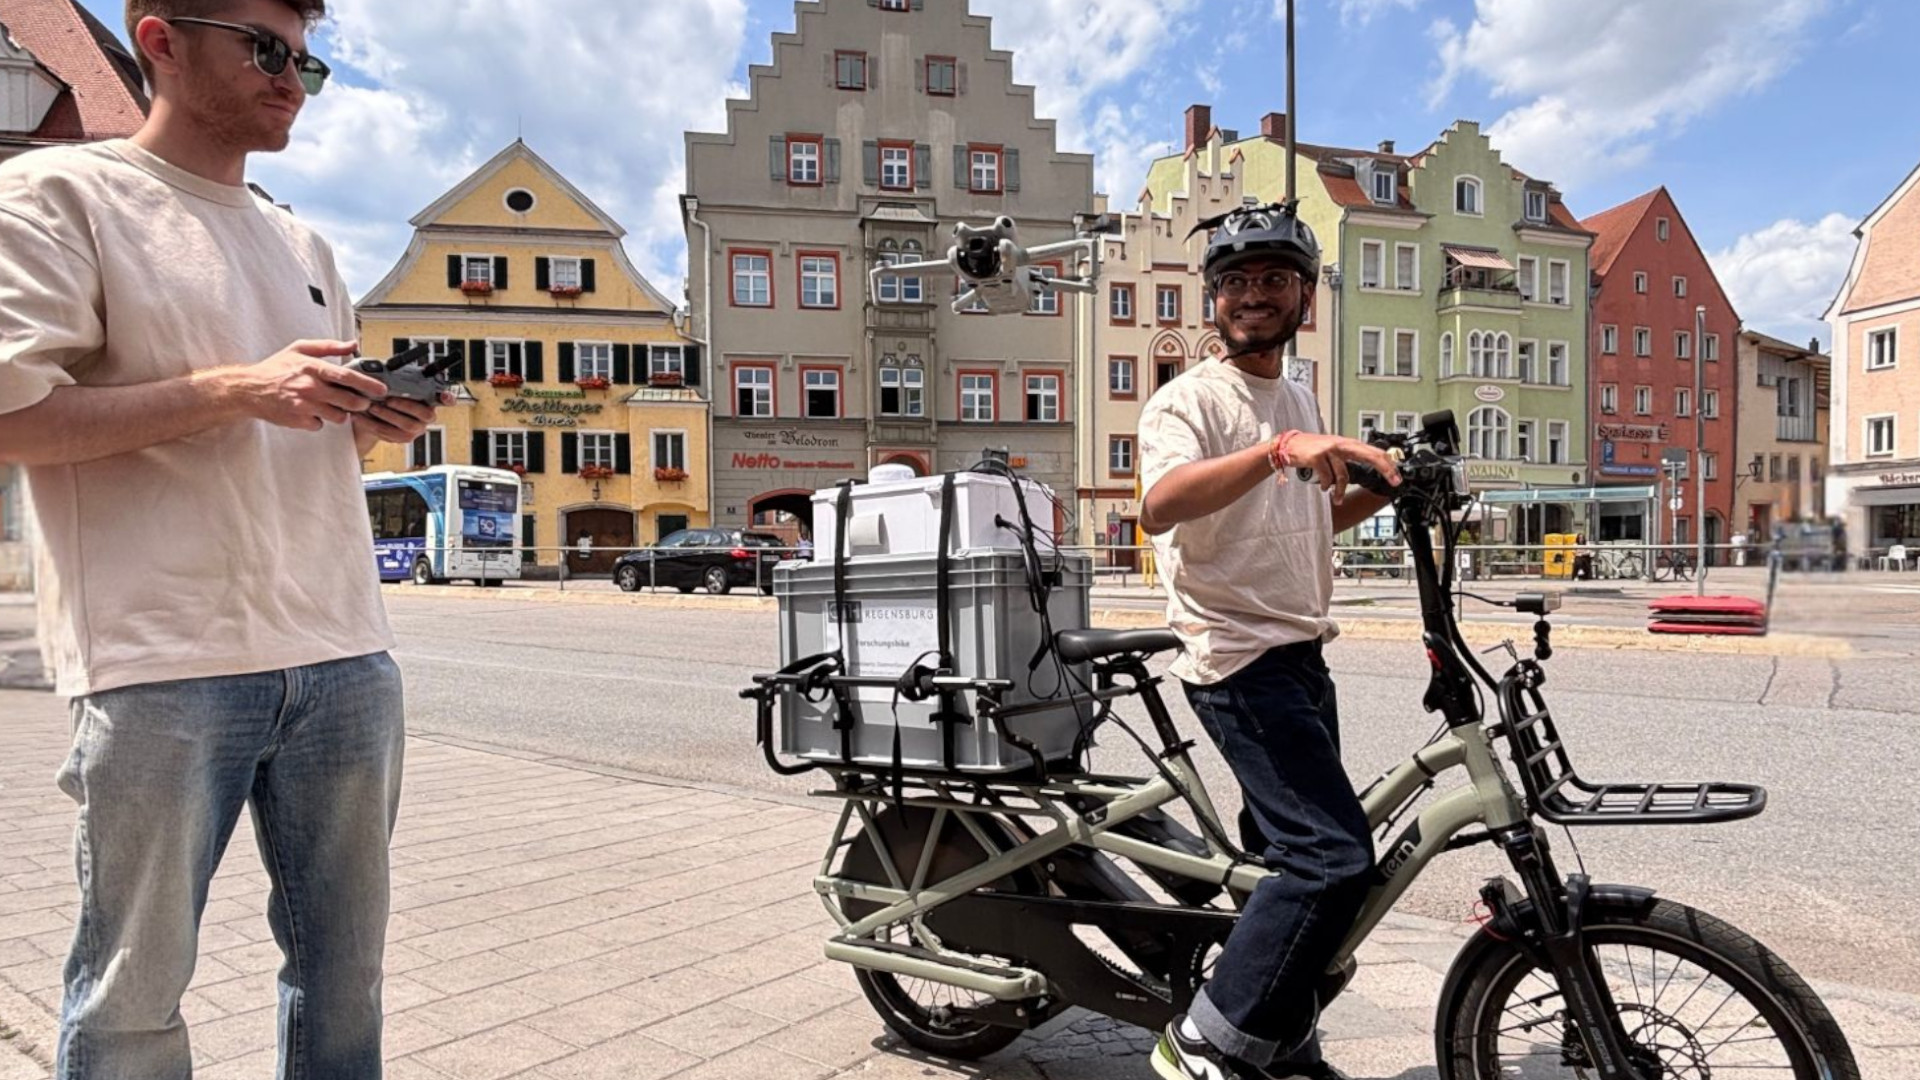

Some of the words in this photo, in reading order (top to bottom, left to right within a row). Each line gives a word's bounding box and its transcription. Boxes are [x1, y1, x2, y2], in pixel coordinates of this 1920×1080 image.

[779, 430, 838, 447] Velodrom
[731, 452, 780, 469] Netto
[865, 608, 934, 620] REGENSBURG
